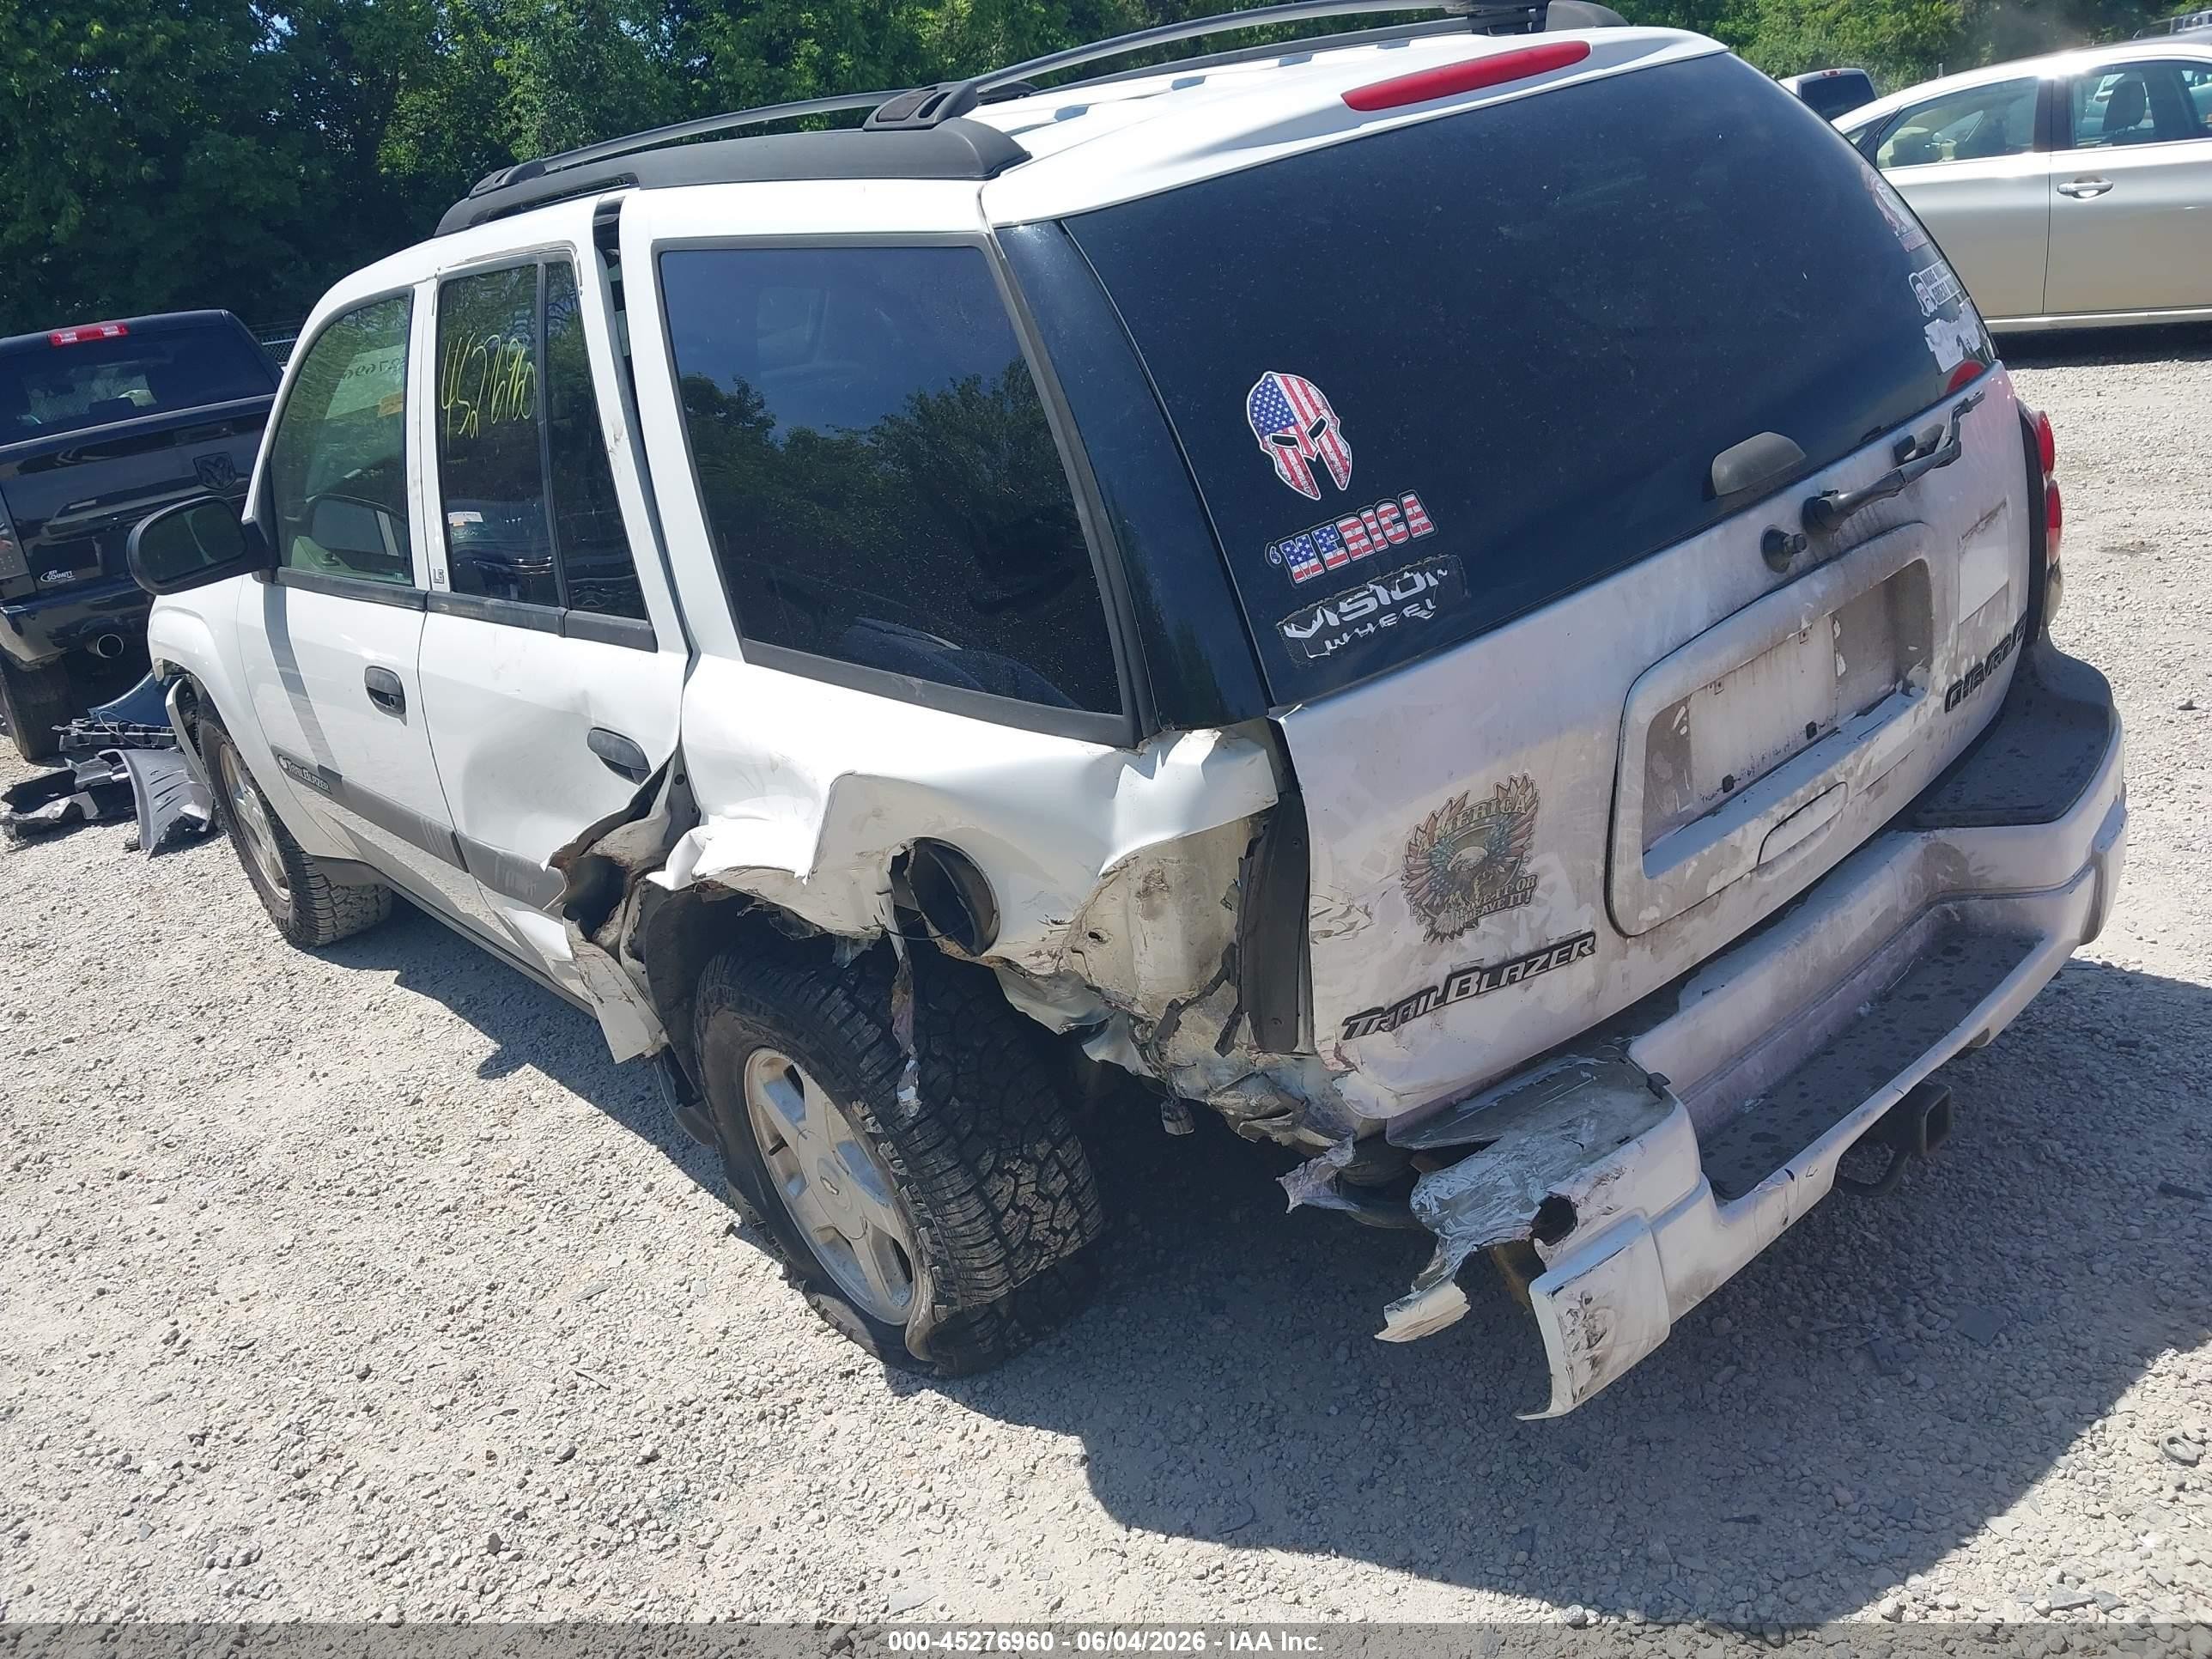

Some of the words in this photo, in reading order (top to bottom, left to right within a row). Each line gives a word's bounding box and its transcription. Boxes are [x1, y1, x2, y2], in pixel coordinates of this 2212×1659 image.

[441, 332, 536, 453] 45276960
[1418, 793, 1527, 856] AMERICA
[1508, 888, 1532, 908] IT!
[1516, 875, 1535, 892] OR
